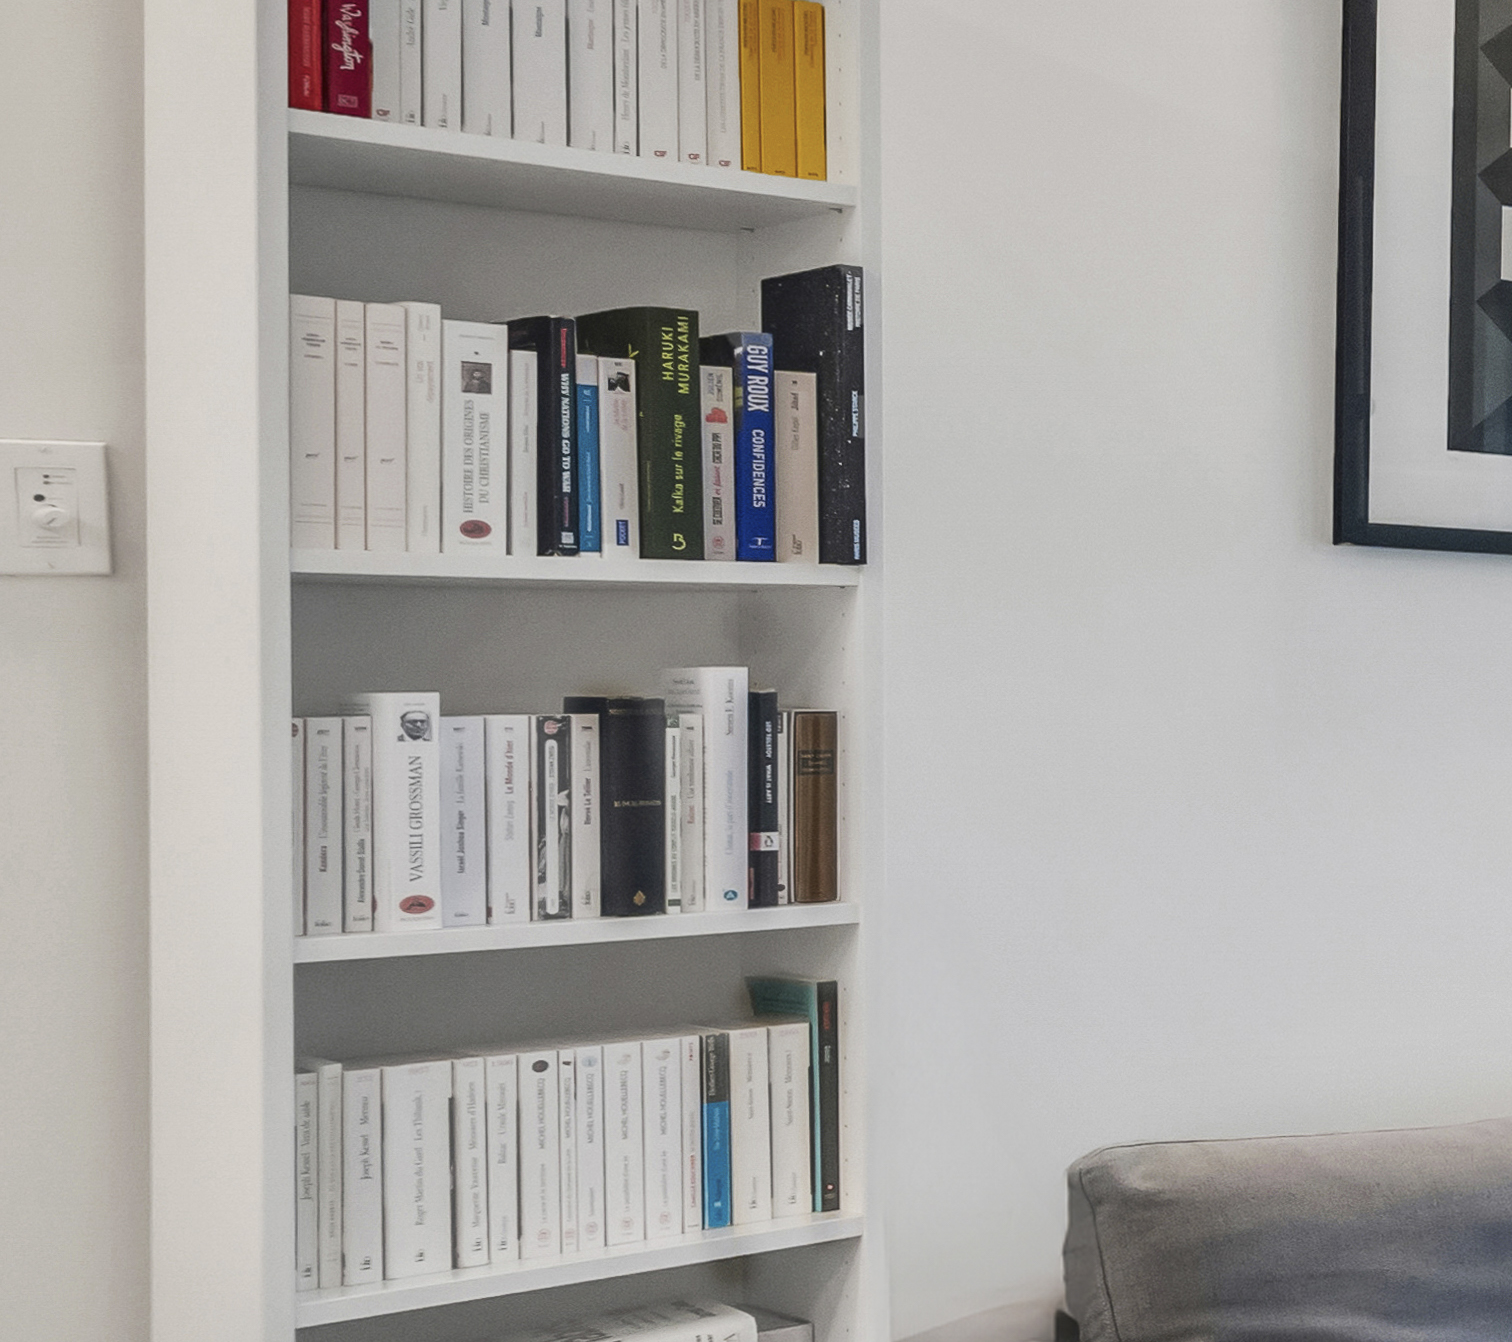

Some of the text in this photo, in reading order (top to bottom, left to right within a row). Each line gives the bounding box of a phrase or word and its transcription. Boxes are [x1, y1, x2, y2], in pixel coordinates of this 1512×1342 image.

[332, 3, 364, 70] Washington
[661, 326, 673, 381] HARUKI
[676, 316, 690, 394] MURAKAMI
[561, 372, 569, 395] WHY
[748, 345, 768, 412] GUY ROUX
[561, 397, 569, 438] NATIONS
[673, 414, 685, 447] rivage
[462, 400, 474, 513] HISTOIRE DES ORIGINES
[478, 413, 489, 504] DU CHRISTIANISME
[562, 439, 569, 453] GO
[562, 455, 570, 469] TO
[753, 429, 765, 507] CONFIDENCES
[562, 472, 570, 492] WAR
[674, 464, 684, 480] sur
[673, 483, 684, 513] Kafka
[408, 756, 423, 882] VASSILI GROSSMAN
